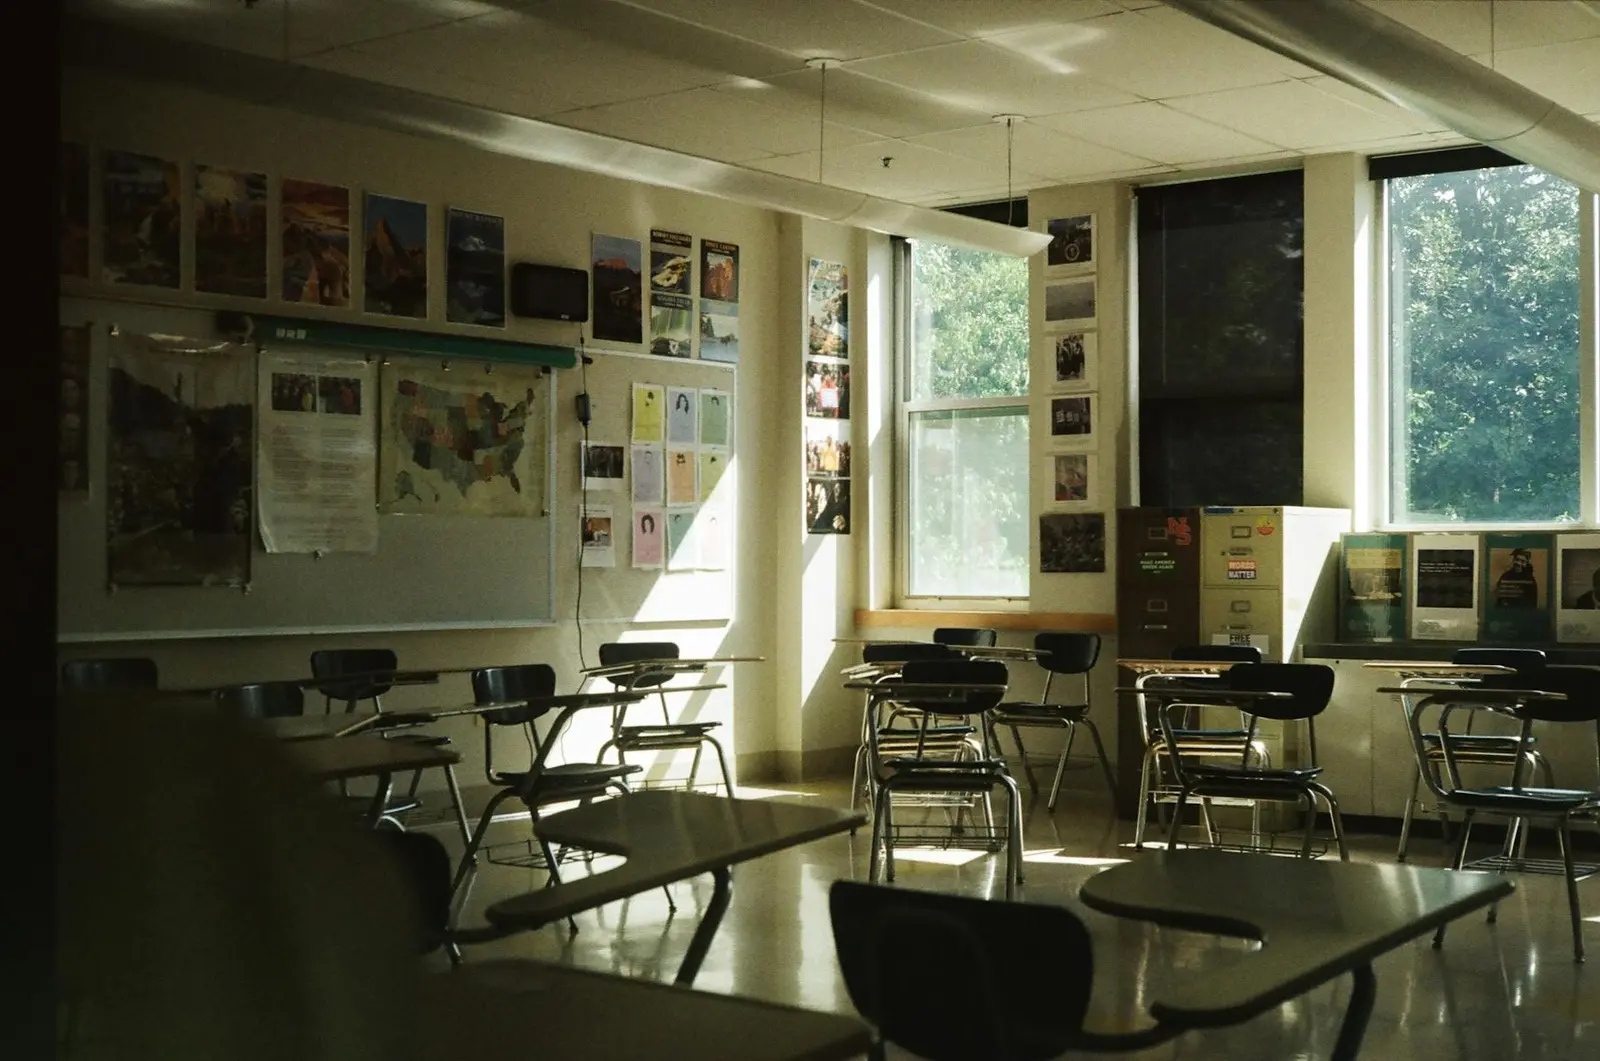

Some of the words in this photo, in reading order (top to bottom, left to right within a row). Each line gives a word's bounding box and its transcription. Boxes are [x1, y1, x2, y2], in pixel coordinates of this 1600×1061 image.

[1228, 561, 1256, 569] WORDS
[1228, 570, 1255, 578] MATTER
[1229, 633, 1251, 642] FREE
